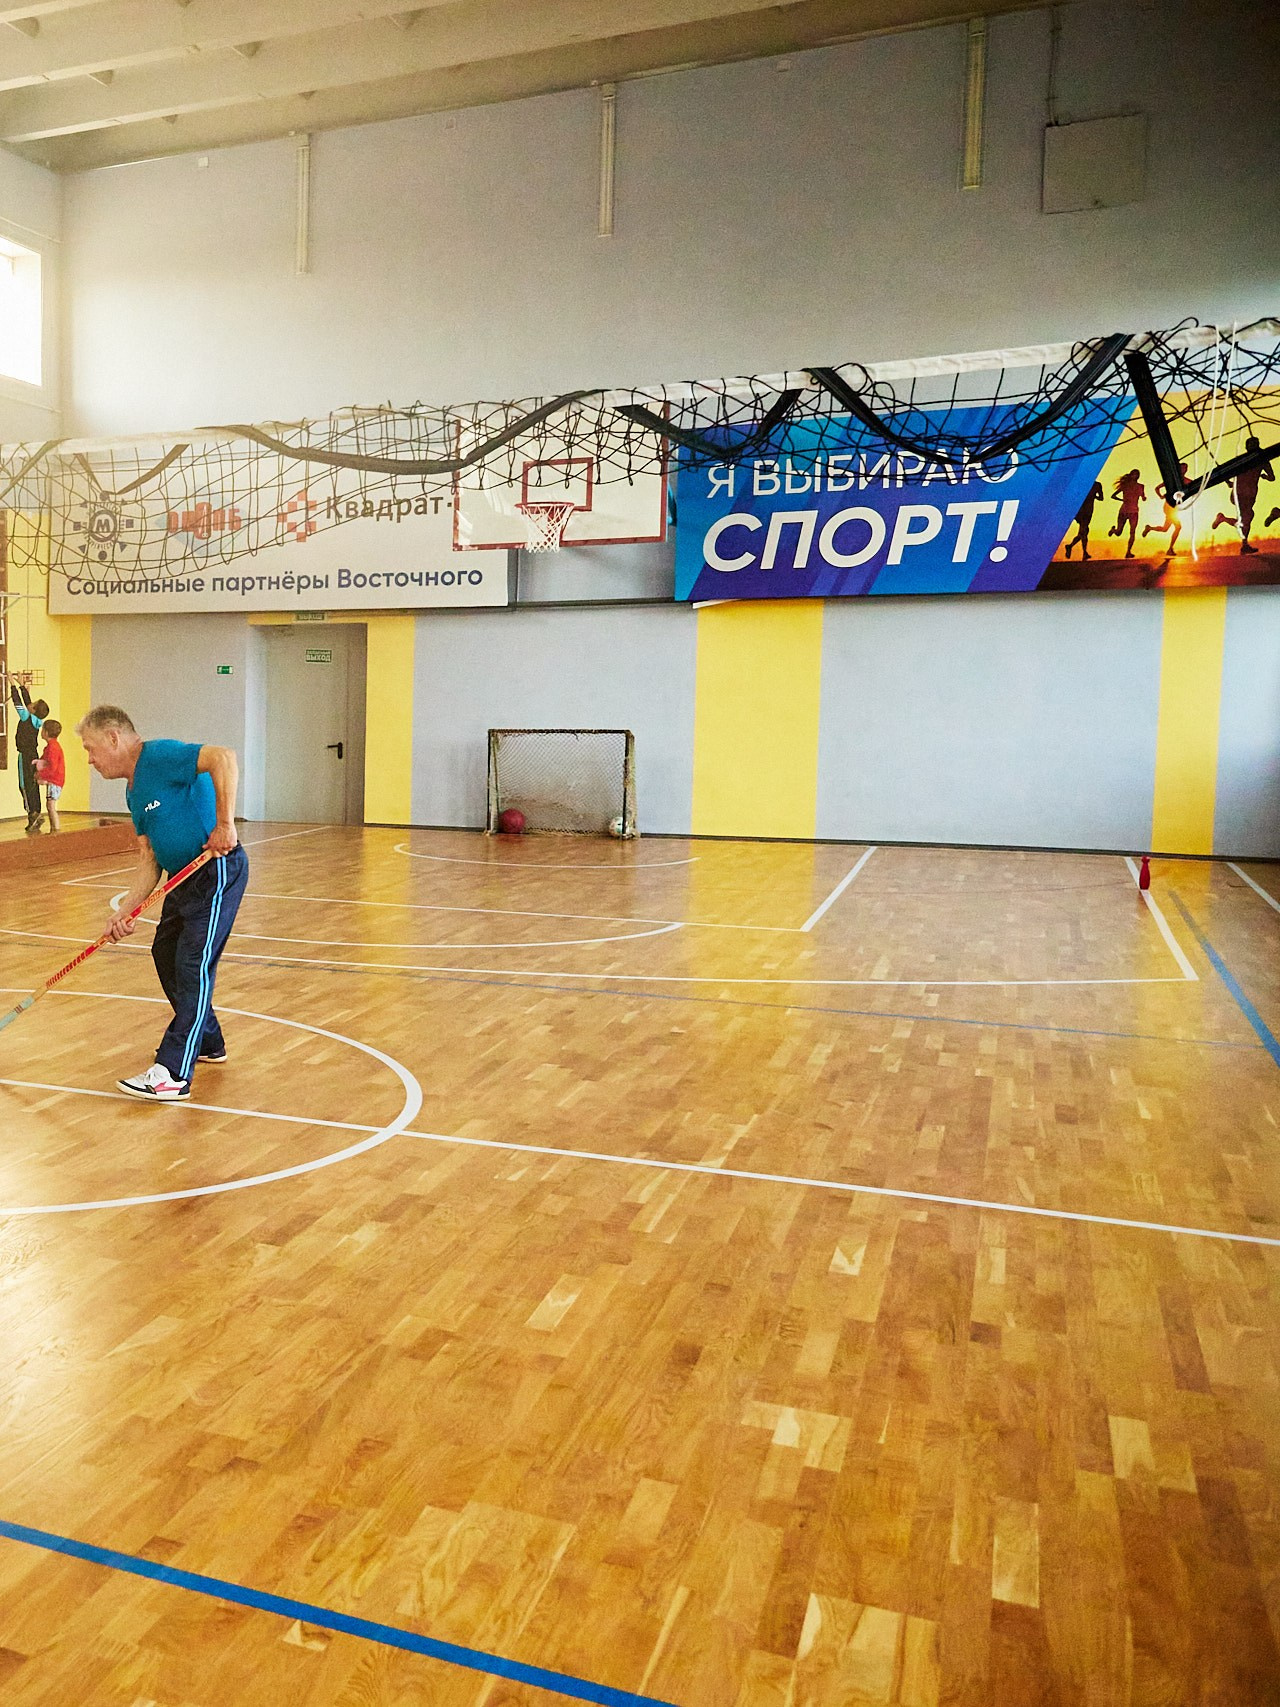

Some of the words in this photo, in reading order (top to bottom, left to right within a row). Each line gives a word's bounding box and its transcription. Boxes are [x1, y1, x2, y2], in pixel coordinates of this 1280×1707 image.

[706, 461, 735, 499] Я
[752, 446, 1019, 496] ВЫБИРАЮ
[326, 496, 444, 523] Квадрат
[702, 499, 1020, 572] СПОРТ!
[67, 577, 205, 597] Социальные
[212, 571, 329, 596] партнёры
[337, 568, 483, 589] Восточного
[306, 654, 331, 662] ВЫХОД
